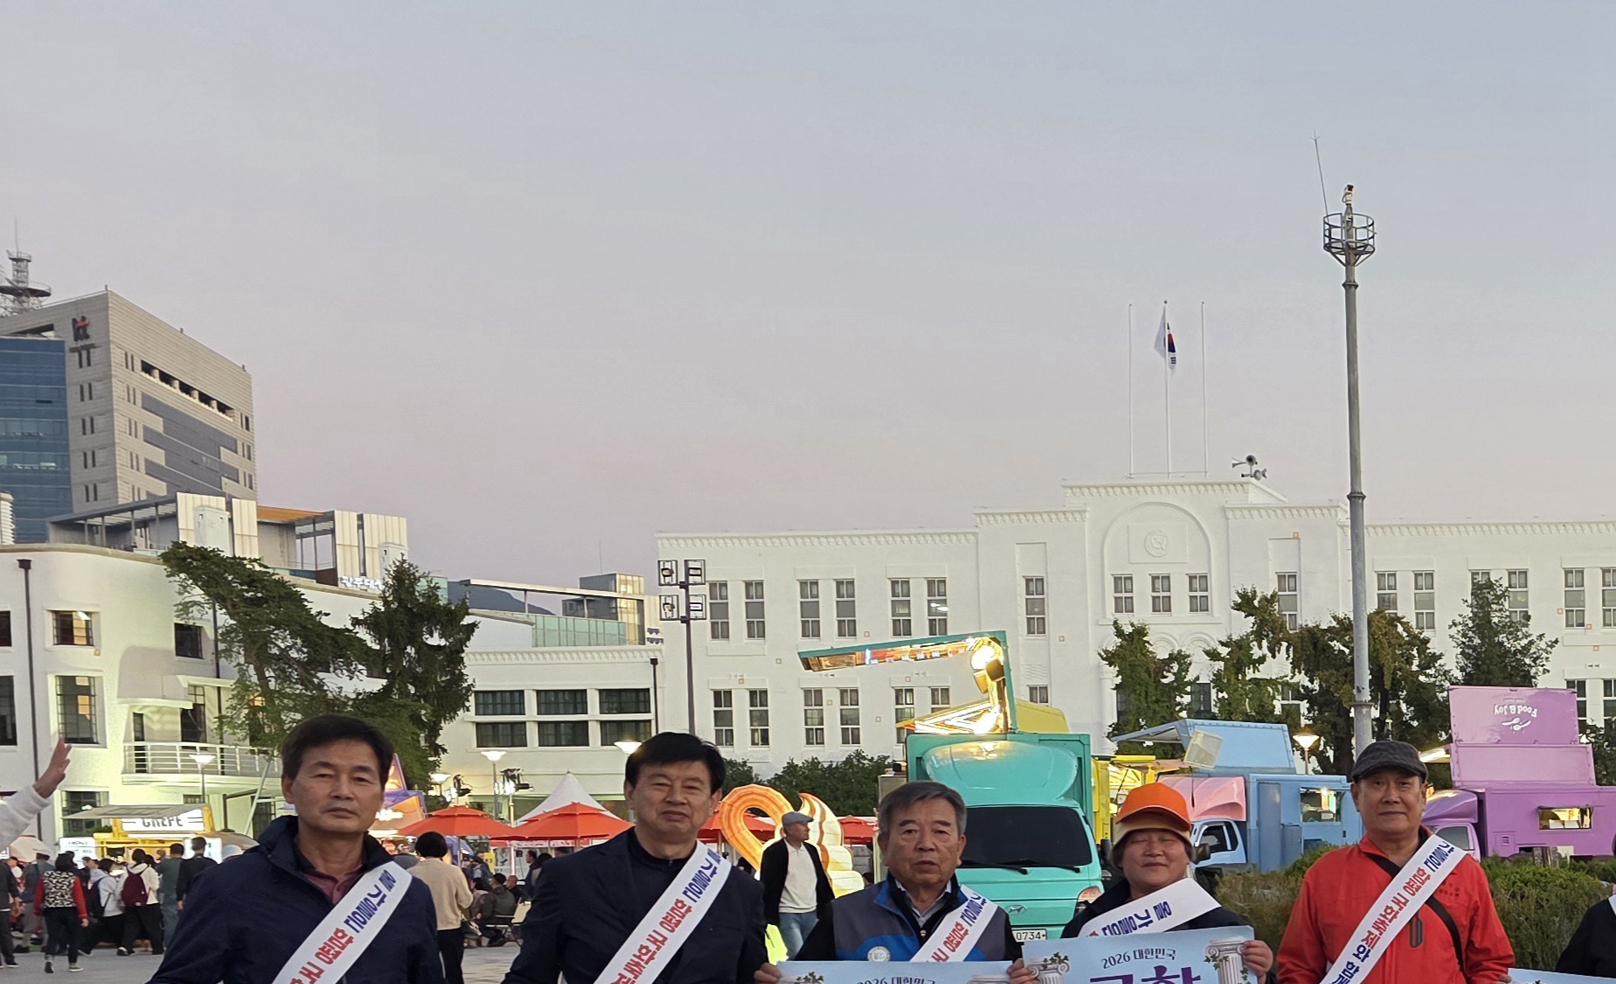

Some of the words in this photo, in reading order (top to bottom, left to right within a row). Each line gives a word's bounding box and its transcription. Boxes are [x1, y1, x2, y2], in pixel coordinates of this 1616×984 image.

[1402, 867, 1432, 897] 함평
[343, 884, 387, 934] 가을은
[659, 898, 693, 934] 함평
[1153, 900, 1172, 921] 올
[942, 921, 969, 953] 함평
[1016, 931, 1041, 941] 0734
[1352, 892, 1410, 963] 국화축제와
[314, 927, 355, 965] 함평
[1101, 953, 1131, 970] 2026
[1133, 947, 1177, 961] 대한민국
